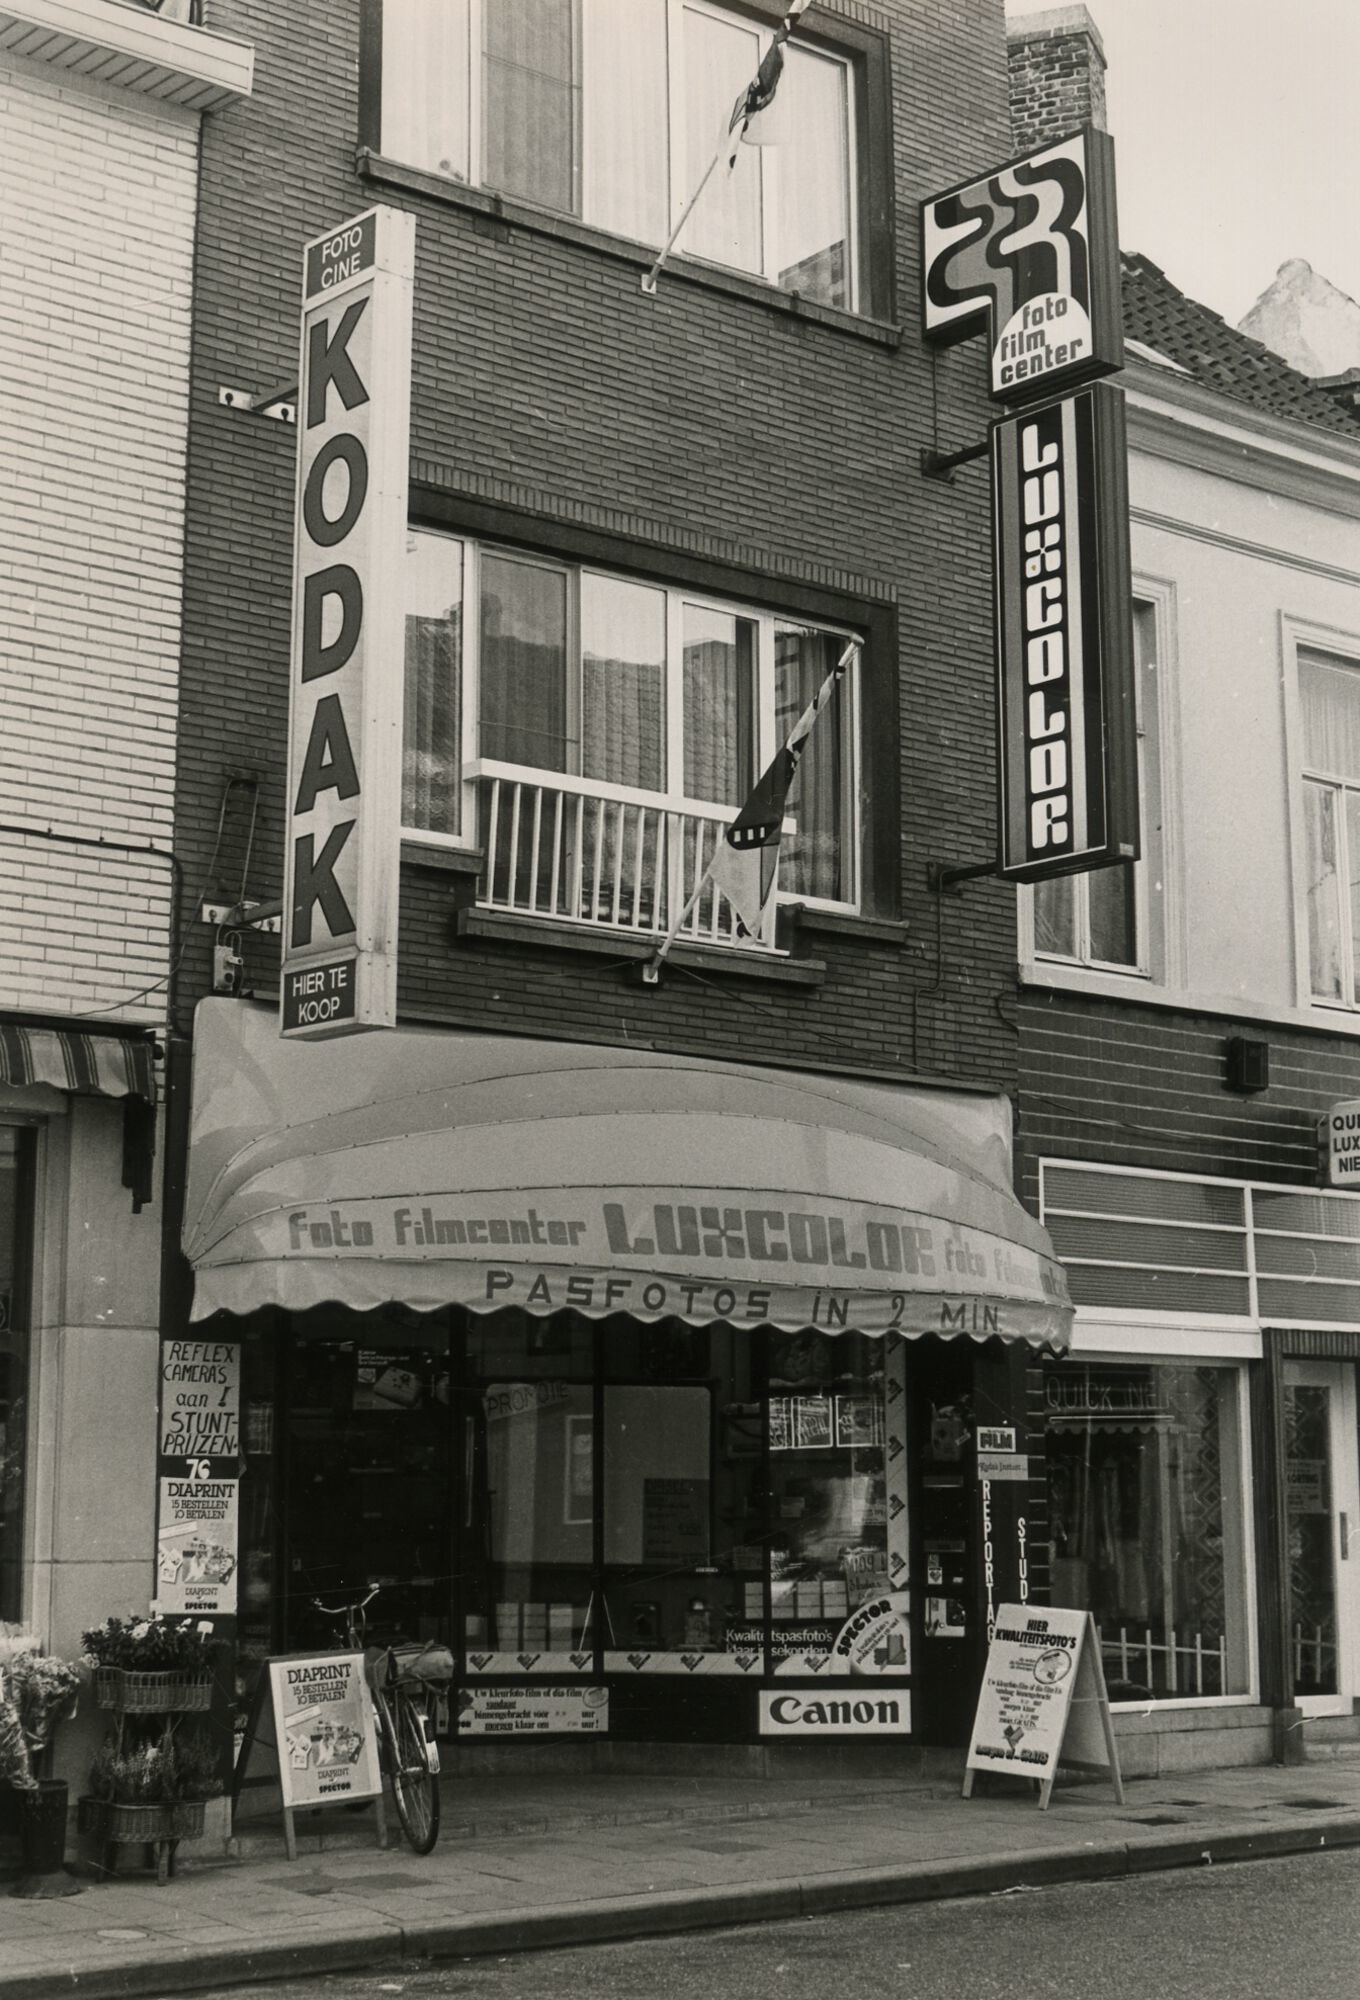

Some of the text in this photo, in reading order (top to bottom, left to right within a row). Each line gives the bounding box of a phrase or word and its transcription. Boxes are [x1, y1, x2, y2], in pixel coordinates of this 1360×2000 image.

[322, 226, 362, 263] FOTO
[321, 252, 361, 289] CINE
[1023, 297, 1068, 330] foto
[1001, 329, 1046, 362] film
[1001, 338, 1083, 385] center
[291, 296, 370, 948] KODAK
[1022, 423, 1068, 850] LUXCOLOR
[292, 966, 348, 997] HIER TE
[298, 997, 340, 1024] KOOP
[486, 1270, 770, 1318] PASFOTOS
[888, 1295, 905, 1327] 2
[169, 1342, 234, 1363] REFLEX
[176, 1393, 208, 1408] aan
[186, 1458, 211, 1479] 76
[168, 1483, 235, 1498] DIAPRINT
[171, 1500, 229, 1509] 15 BESTELLEN
[184, 1510, 225, 1519] BETALEN
[982, 1479, 996, 1646] REPORTAG
[1017, 1517, 1029, 1605] STUD
[836, 1599, 892, 1657] SPECTOR
[995, 1629, 1076, 1649] KWALITEITSFOTO'S
[1026, 1619, 1049, 1632] HIER
[288, 1663, 352, 1684] DIAPRINT
[302, 1680, 348, 1694] BESTELLEN
[308, 1691, 346, 1704] BETALEN
[769, 1696, 900, 1725] Canon
[319, 1782, 351, 1794] SPECTOR
